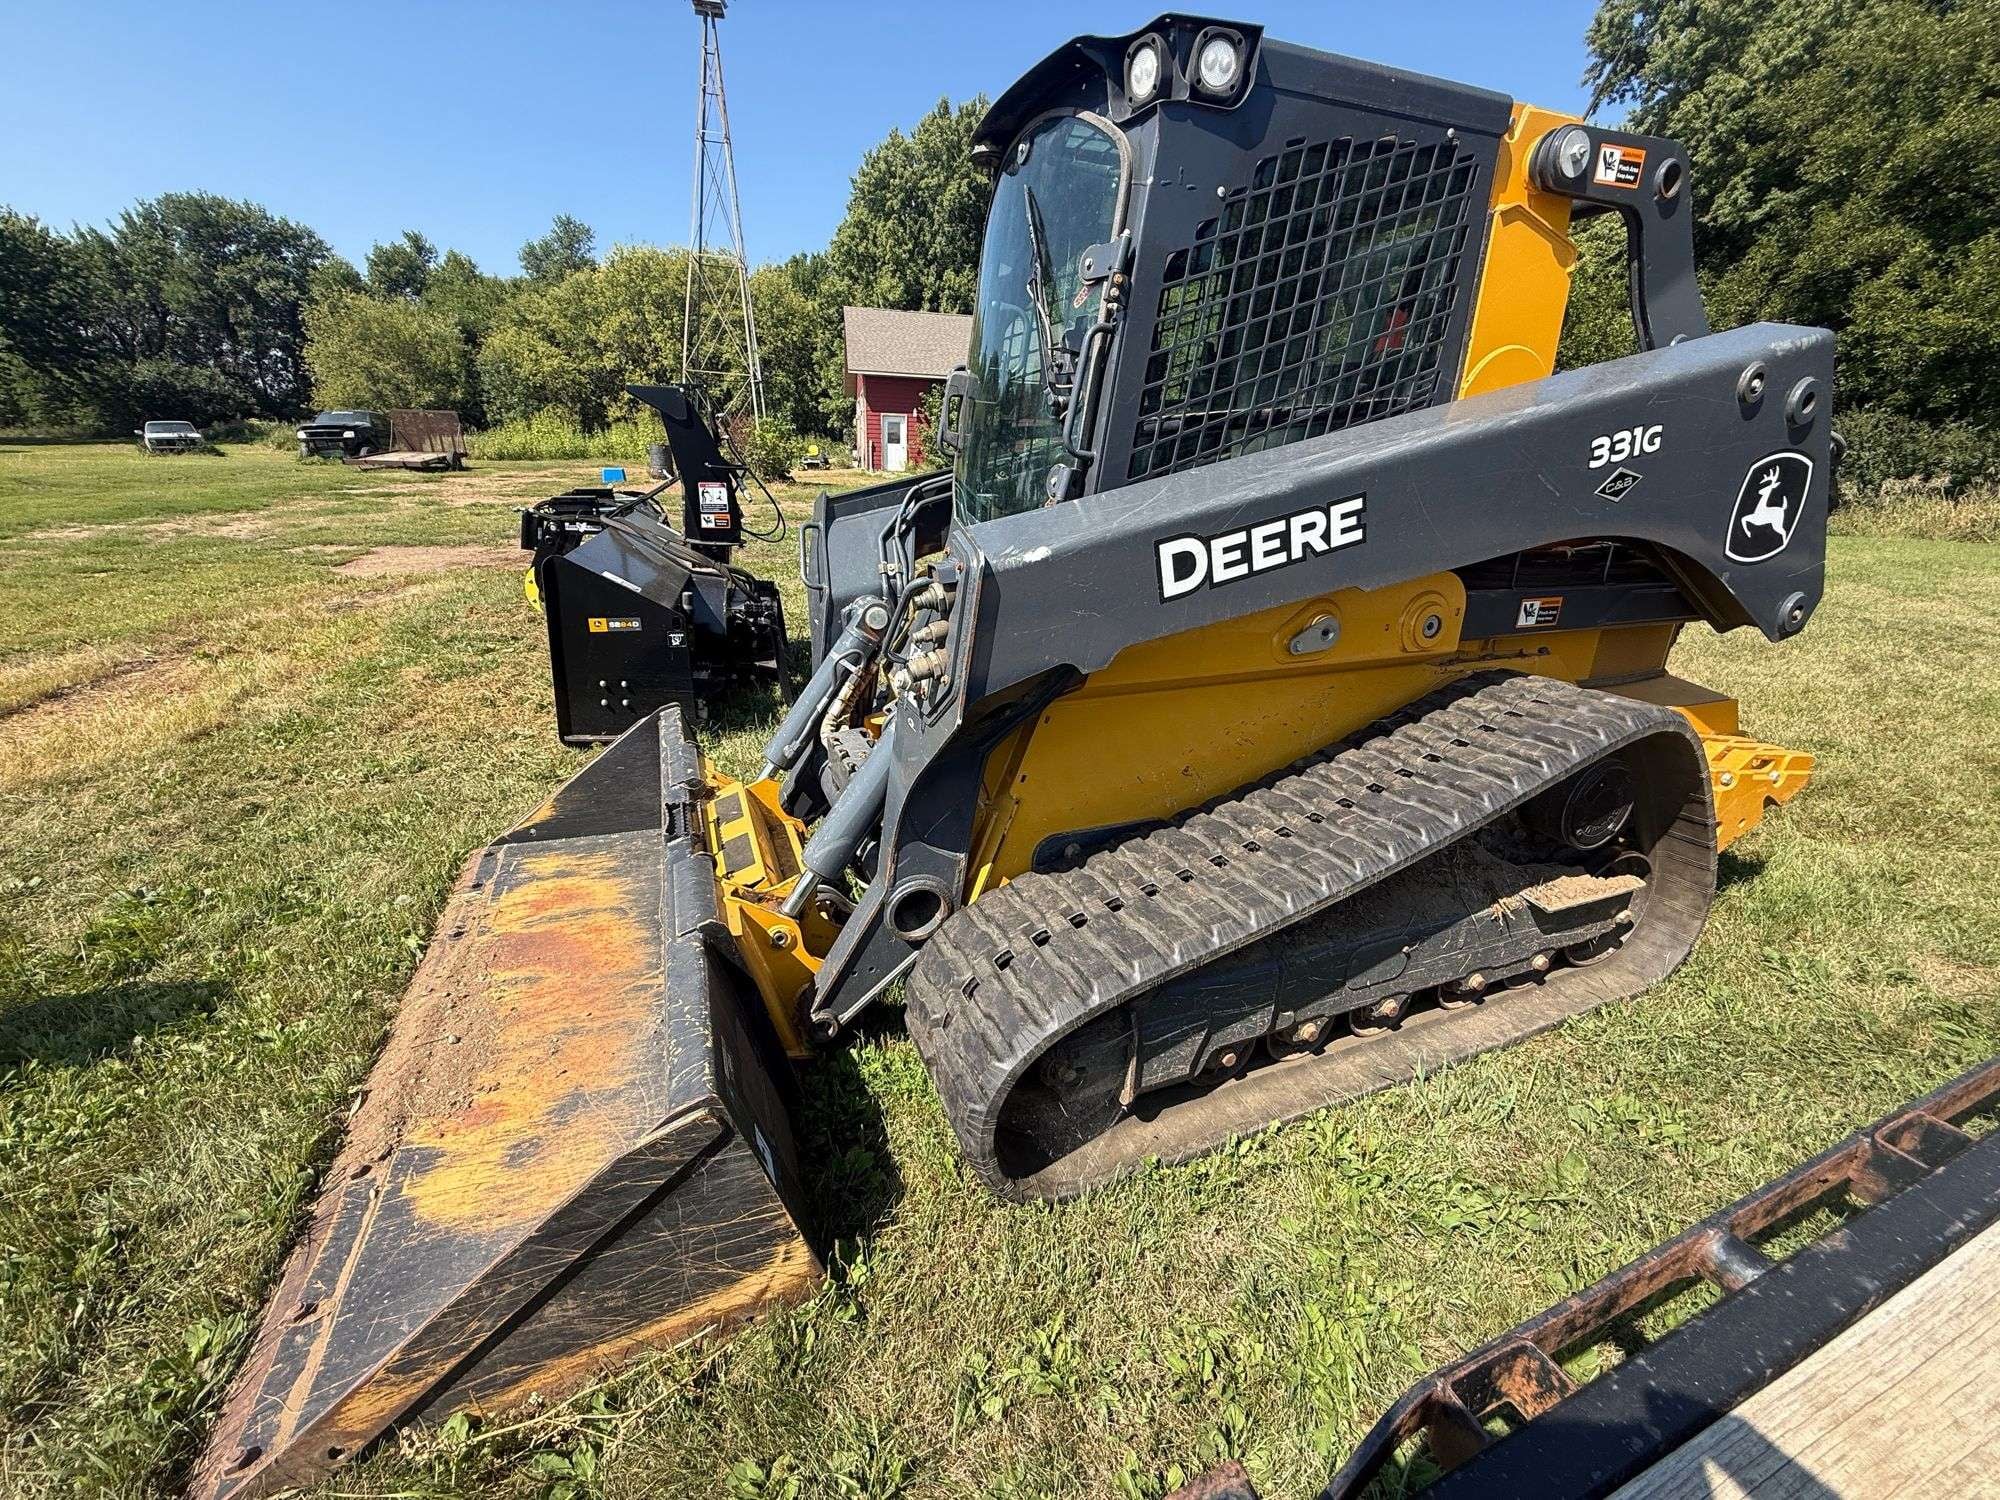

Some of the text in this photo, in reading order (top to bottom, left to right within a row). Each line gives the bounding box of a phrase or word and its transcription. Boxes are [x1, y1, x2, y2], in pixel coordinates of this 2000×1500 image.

[1588, 425, 1663, 469] 331G
[1605, 477, 1633, 493] C&B
[1158, 497, 1363, 599] DEERE
